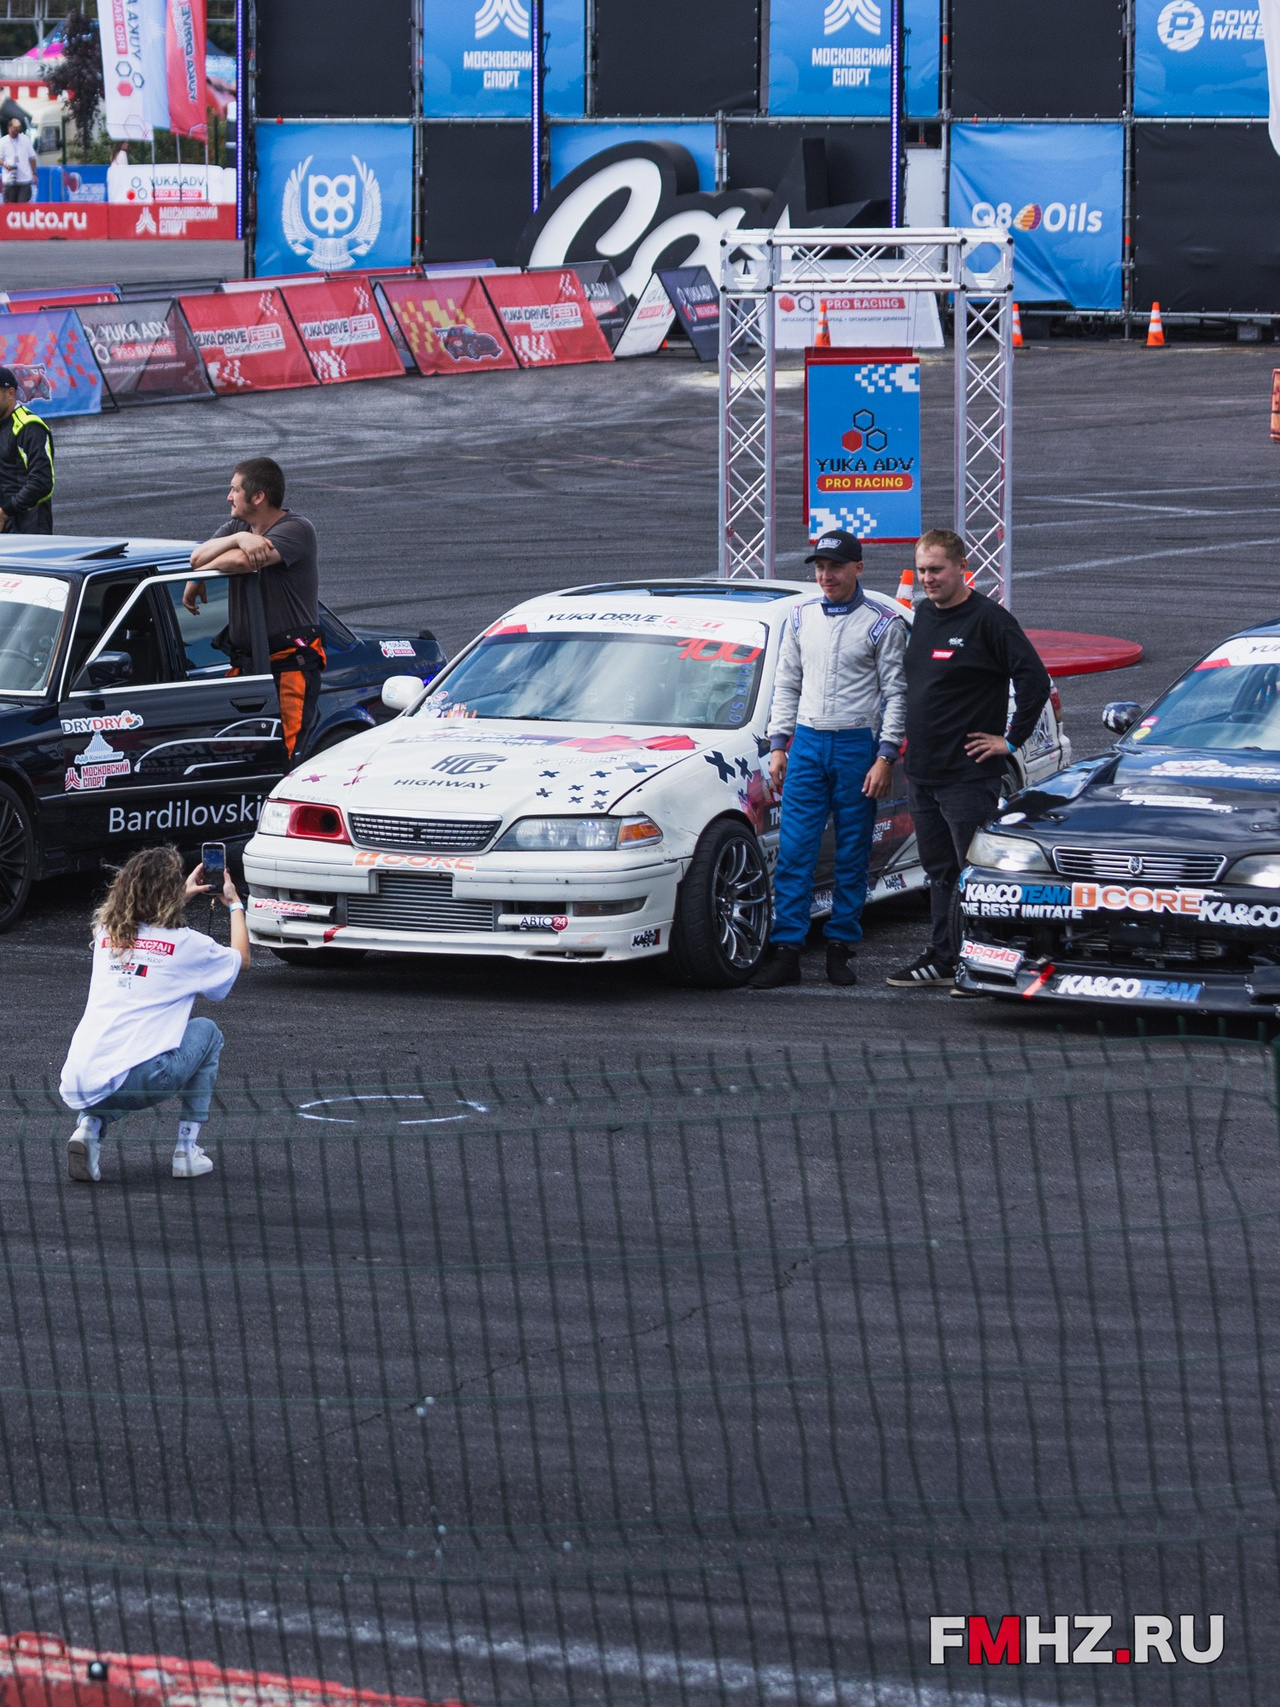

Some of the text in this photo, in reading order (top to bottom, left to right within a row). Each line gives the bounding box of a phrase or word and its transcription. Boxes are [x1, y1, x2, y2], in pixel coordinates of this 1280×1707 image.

[812, 44, 892, 66] МОСКОВСКИЙ
[483, 71, 520, 89] СПОРТ
[833, 68, 870, 87] СПОРТ
[149, 177, 205, 187] YUKA ADV
[6, 209, 87, 230] auto.ru
[159, 204, 218, 221] МОСКОВСКИЙ
[971, 202, 1103, 233] Q8 Oils
[159, 219, 187, 235] СПОРТ
[826, 298, 900, 309] PRO RACING
[502, 303, 579, 322] YUKA DRIVE FEST
[100, 320, 170, 343] YUKA ADV
[300, 315, 376, 338] YUKA DRIVE FEST
[217, 329, 247, 346] DRIVE
[251, 325, 280, 341] FEST
[117, 343, 172, 358] PRO RACING
[816, 457, 914, 473] YUKA ADV
[825, 477, 904, 488] PRO RACING
[546, 612, 598, 622] YUKA
[599, 613, 662, 623] DRIVE
[676, 638, 762, 664] 100
[62, 717, 122, 734] DRYDRY
[82, 760, 130, 777] МОСКОВСКИЙ
[83, 775, 106, 788] СПОРТ
[394, 779, 491, 789] HIGHWAY
[109, 794, 261, 833] Bardilovski
[960, 902, 1083, 919] THE REST IMITATE
[964, 944, 1019, 963] ДРАЙВ
